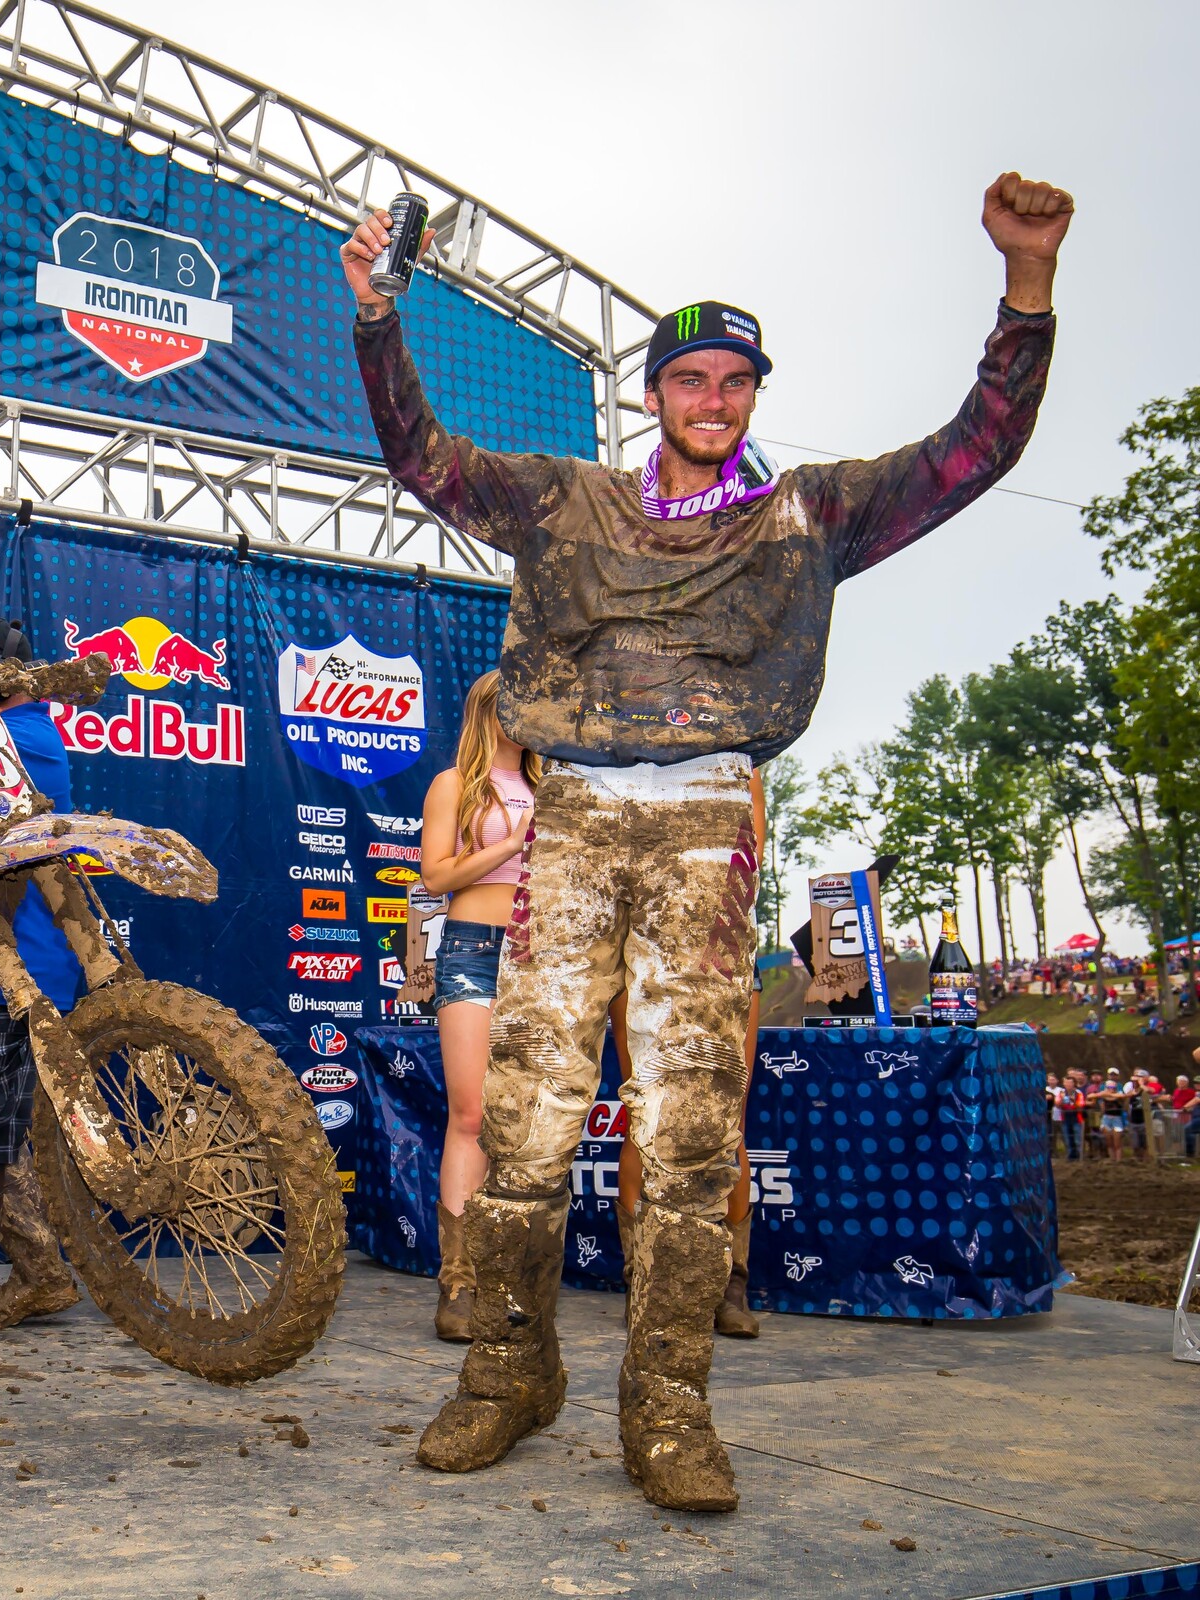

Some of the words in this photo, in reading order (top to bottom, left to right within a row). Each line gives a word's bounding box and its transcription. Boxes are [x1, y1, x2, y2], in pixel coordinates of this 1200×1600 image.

[78, 230, 196, 287] 2018
[85, 281, 188, 326] IRONMAN
[730, 313, 757, 332] YAMAHA
[82, 318, 190, 349] NATIONAL
[665, 473, 746, 519] 100%
[357, 660, 369, 669] HI-
[358, 672, 421, 685] PERFORMANCE
[294, 680, 419, 722] LUCAS
[49, 697, 143, 755] Red
[152, 702, 244, 764] Bull
[287, 724, 320, 743] OIL
[327, 726, 421, 753] PRODUCTS
[341, 753, 373, 774] INC.
[297, 804, 346, 826] WPS
[367, 813, 423, 831] FLY
[299, 831, 346, 848] GEICO
[380, 827, 415, 835] RACING
[309, 844, 346, 855] Motorcycle
[367, 843, 421, 861] MOTOSPOR
[289, 864, 354, 883] GARMIN
[377, 869, 420, 882] FMF
[818, 880, 835, 888] LUCAS
[310, 897, 340, 912] KTM
[373, 902, 407, 918] PIRE
[306, 927, 360, 942] SUZUKI
[420, 914, 447, 961] 1
[830, 908, 865, 957] 3
[290, 954, 324, 969] MX
[328, 956, 362, 970] ATV
[868, 952, 878, 966] OIL
[300, 969, 326, 979] ALL
[327, 970, 349, 980] OUT
[386, 963, 406, 981] 100
[407, 966, 434, 988] IRON
[815, 960, 867, 987] IRONMA
[870, 965, 883, 993] LUCAS
[304, 998, 363, 1013] Husqvarna
[311, 1023, 336, 1056] VP
[307, 1077, 351, 1086] Works
[312, 1068, 348, 1078] Pivot
